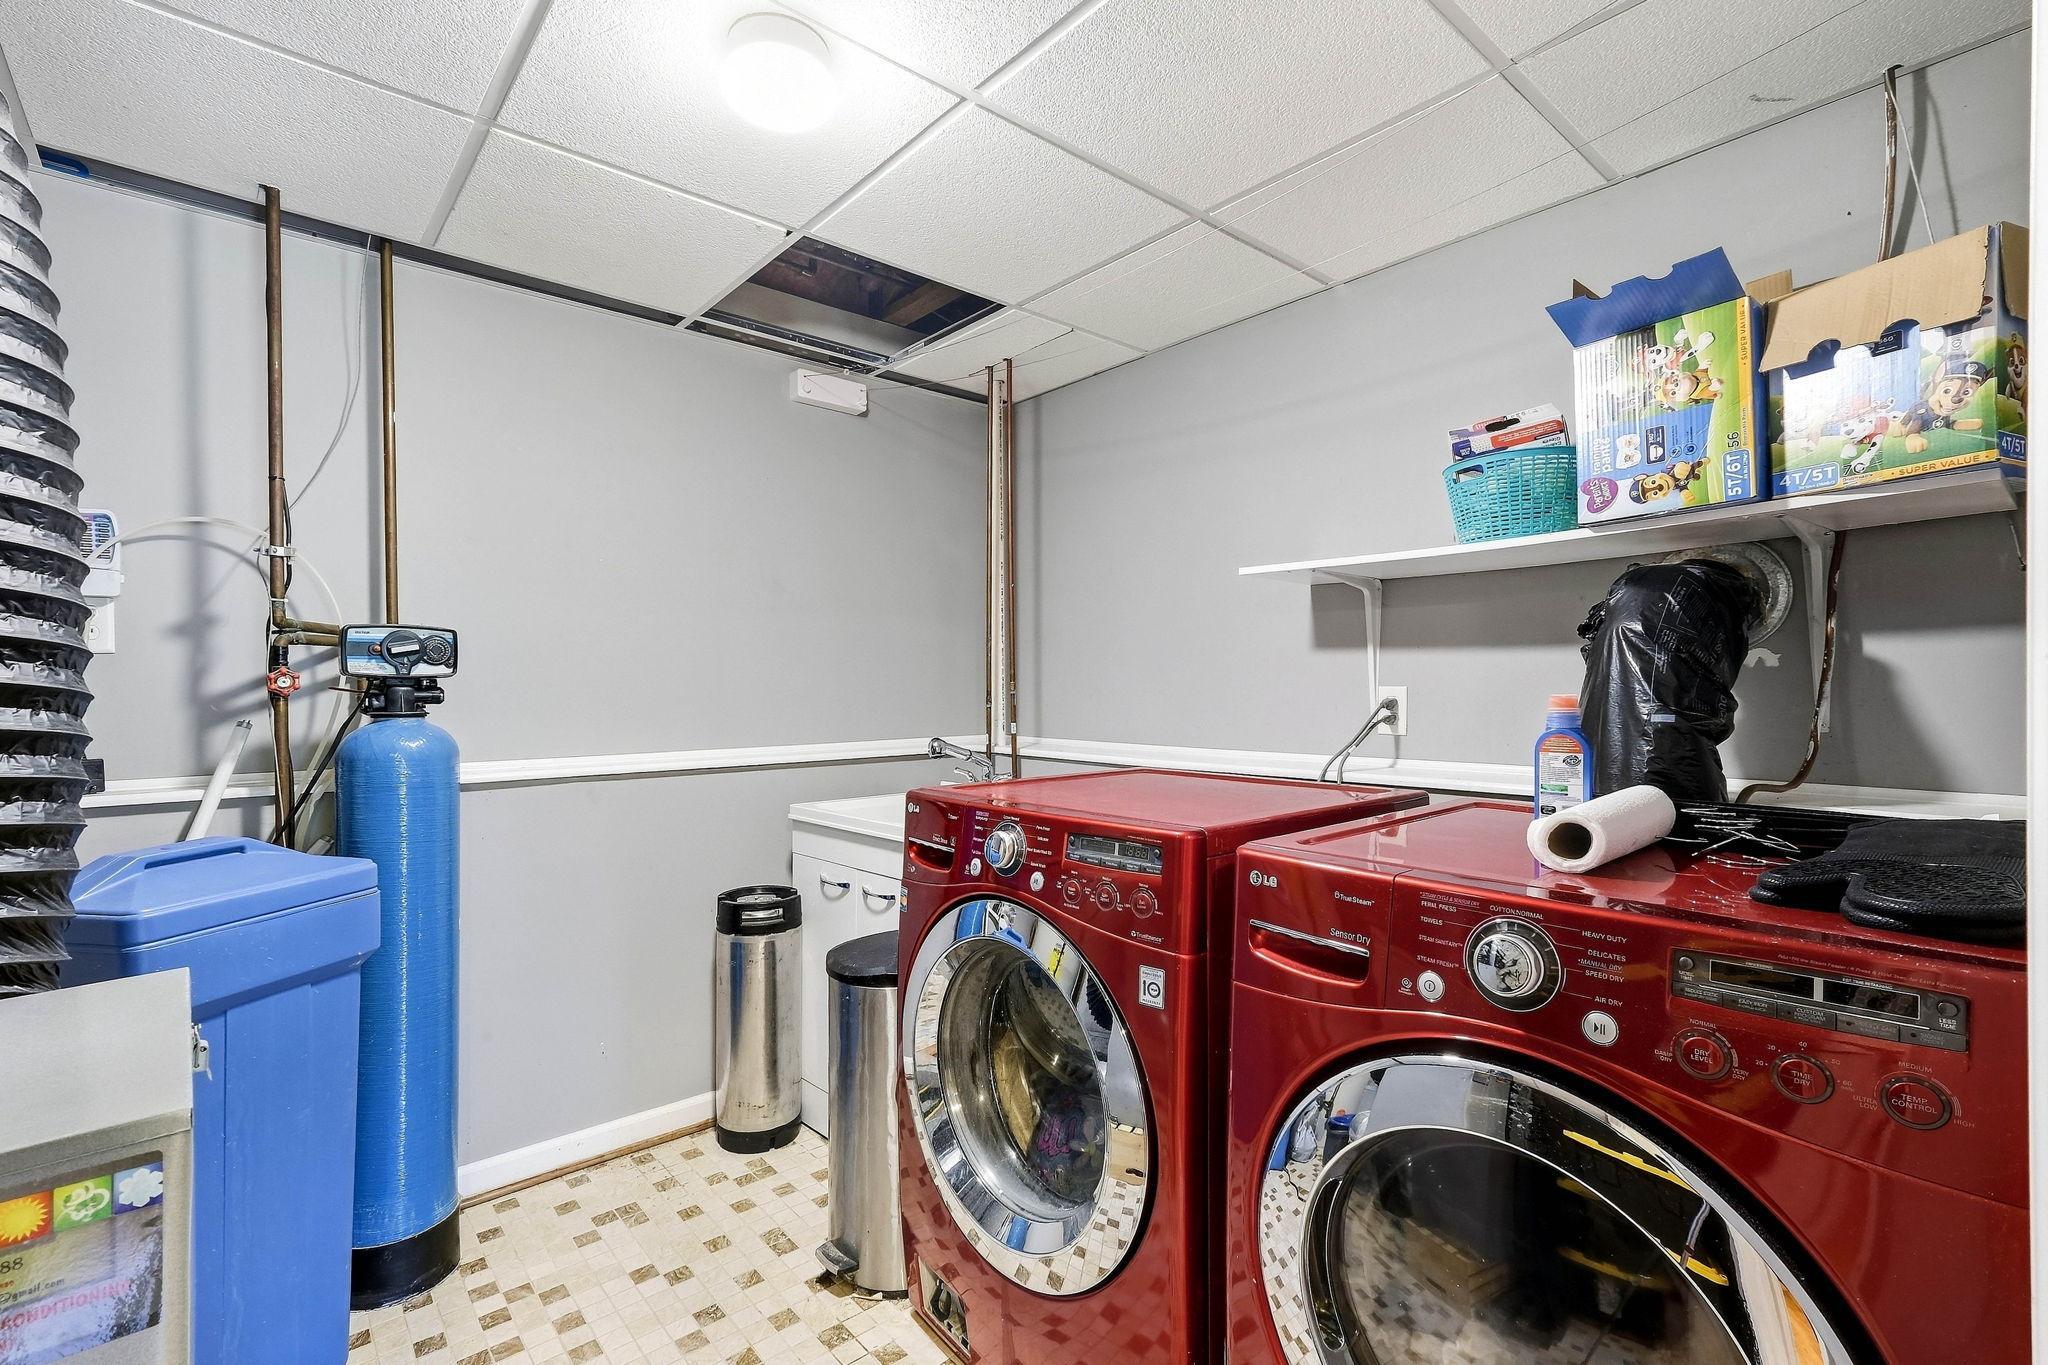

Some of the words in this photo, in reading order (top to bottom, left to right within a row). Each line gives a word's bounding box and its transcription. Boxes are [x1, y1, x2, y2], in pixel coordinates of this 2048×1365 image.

[1740, 336, 1748, 360] SUPER
[1727, 432, 1740, 448] 56
[2001, 436, 2026, 453] 4T/5T
[1899, 462, 1936, 476] SUPER
[1940, 454, 1980, 468] VALUE
[1726, 454, 1743, 496] 5T/6T
[1780, 466, 1836, 487] 4T/5T
[1263, 874, 1278, 888] LG
[1420, 915, 1443, 926] TOWELS
[1330, 927, 1356, 941] Sensor
[1357, 934, 1371, 946] Dry
[1582, 930, 1606, 940] HEAVY
[1606, 934, 1627, 944] DUTY
[1587, 949, 1626, 962] DELICATES
[1585, 969, 1608, 980] SPEED
[1609, 974, 1625, 983] DRY
[1594, 996, 1607, 1004] AIR
[1607, 999, 1623, 1008] DRY
[1688, 1017, 1717, 1029] NORMAL
[1690, 1053, 1713, 1064] LEVEL
[1694, 1048, 1710, 1057] DRY
[1898, 1060, 1933, 1074] MEDIUM
[1791, 1070, 1813, 1080] TIME
[1794, 1077, 1811, 1086] DRY
[1853, 1095, 1878, 1106] ULTRA
[1860, 1101, 1878, 1111] LOW
[1891, 1098, 1938, 1114] CONTROL
[1954, 1118, 1975, 1129] HIGH
